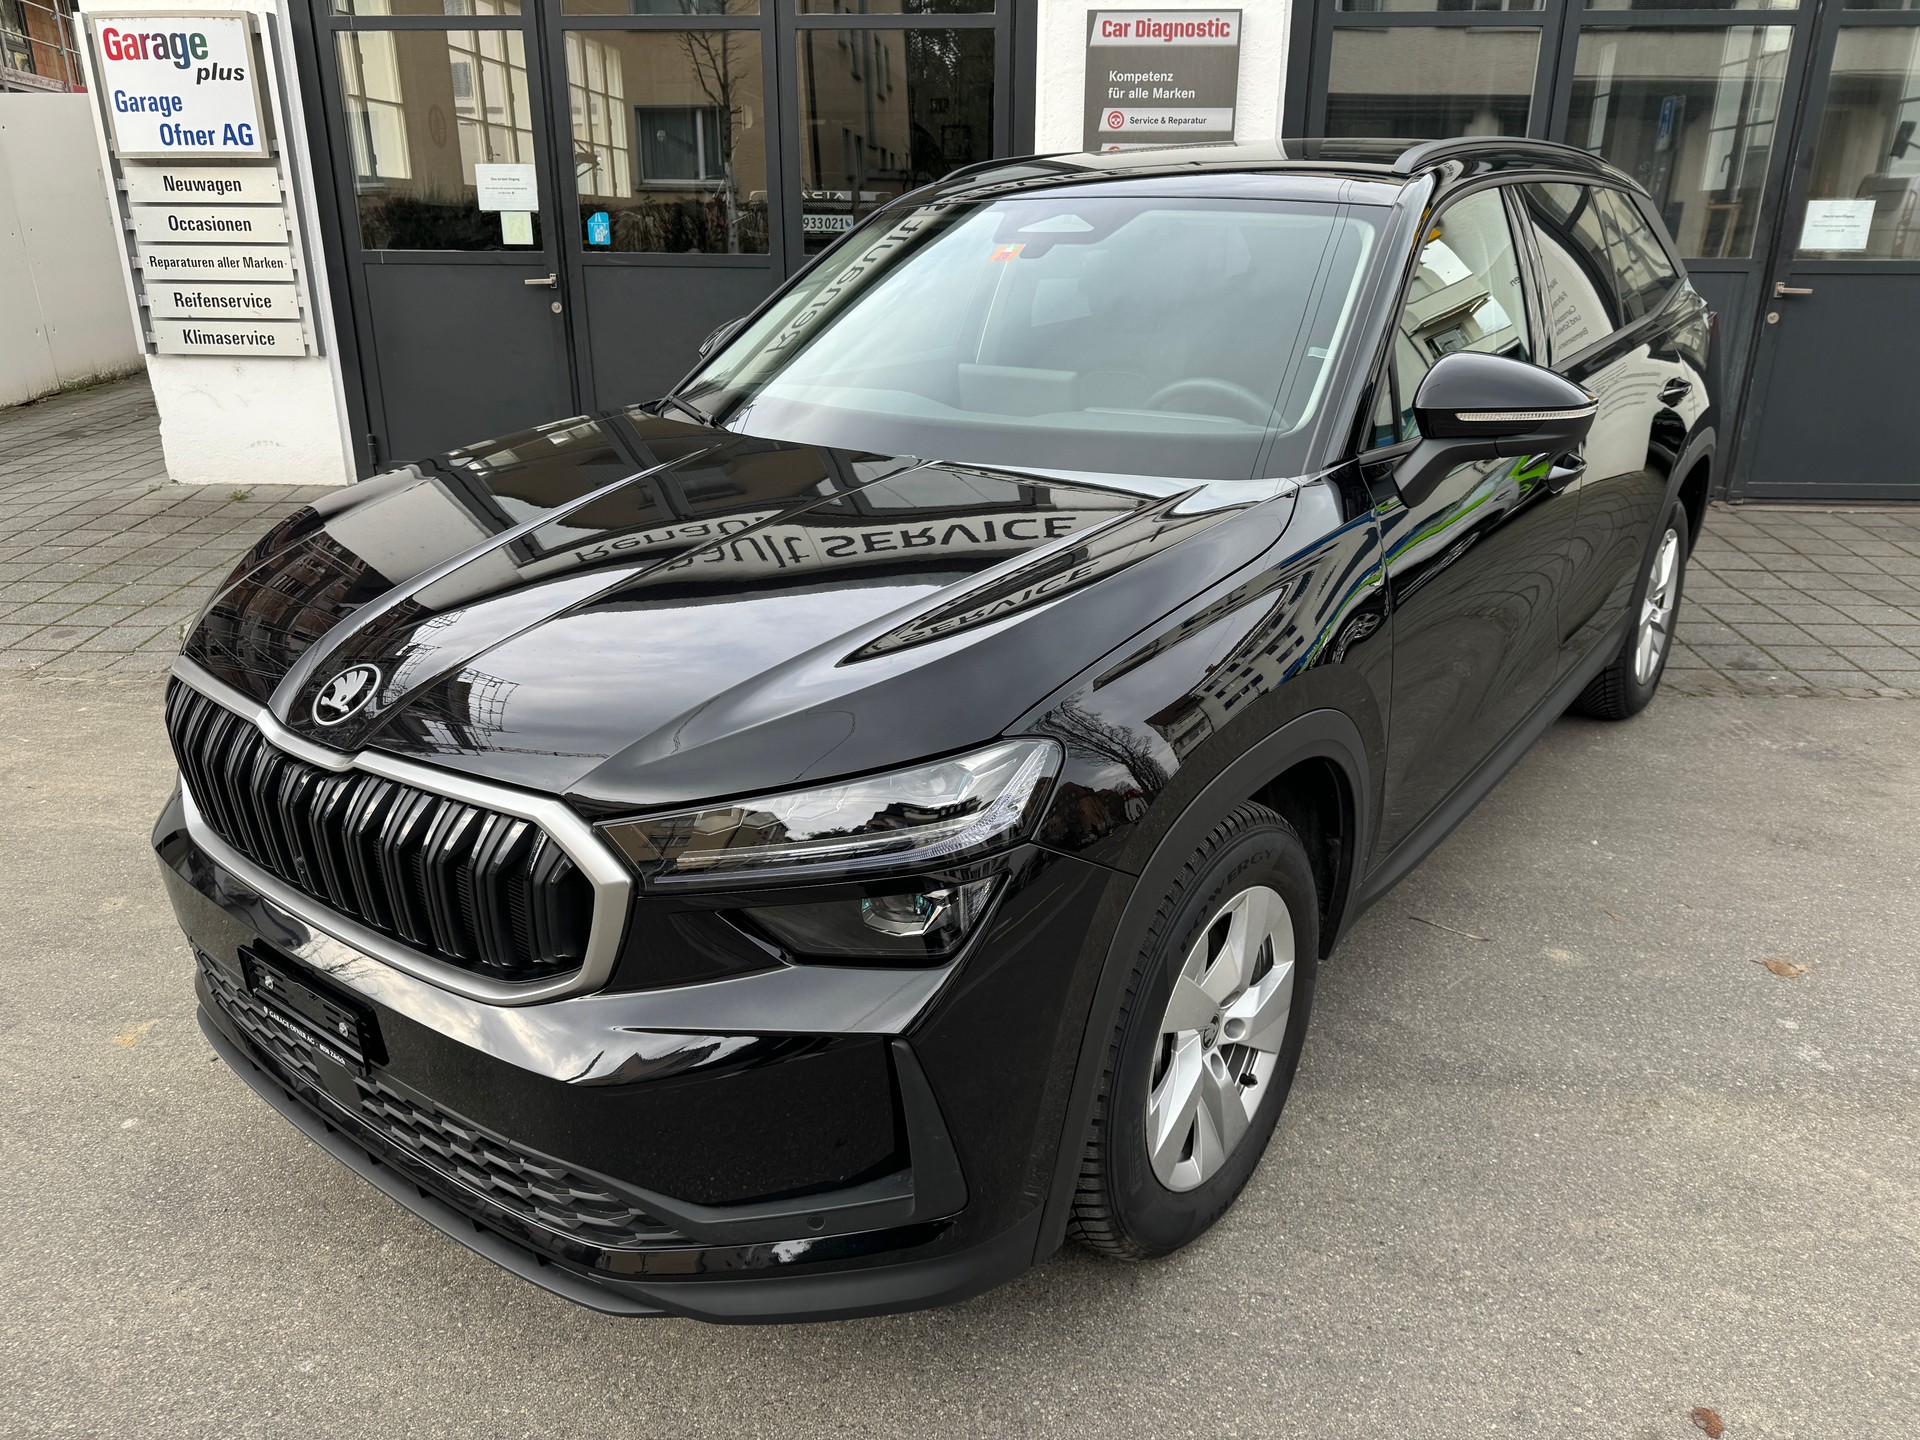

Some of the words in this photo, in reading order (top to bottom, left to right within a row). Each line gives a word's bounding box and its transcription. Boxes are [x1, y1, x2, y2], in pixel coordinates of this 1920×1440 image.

[1102, 20, 1131, 38] Car
[1135, 17, 1231, 43] Diagnostic
[102, 27, 209, 70] Garage
[196, 62, 245, 85] plus
[1109, 70, 1174, 84] Kompetenz
[1108, 87, 1125, 99] für
[1128, 87, 1149, 99] alle
[1152, 87, 1195, 99] Marken
[114, 89, 183, 118] Garage
[1129, 116, 1159, 125] Service
[1160, 116, 1166, 125] &
[1168, 116, 1207, 126] Reparatur
[159, 123, 215, 146] Ofner
[222, 123, 254, 146] AG
[162, 175, 242, 195] Neuwagen
[167, 215, 252, 232] Occasionen
[149, 255, 215, 271] Reparaturen
[217, 257, 240, 269] aller
[242, 257, 284, 269] Marken
[173, 292, 272, 309] Reifenservice
[182, 329, 275, 346] Klimaservice
